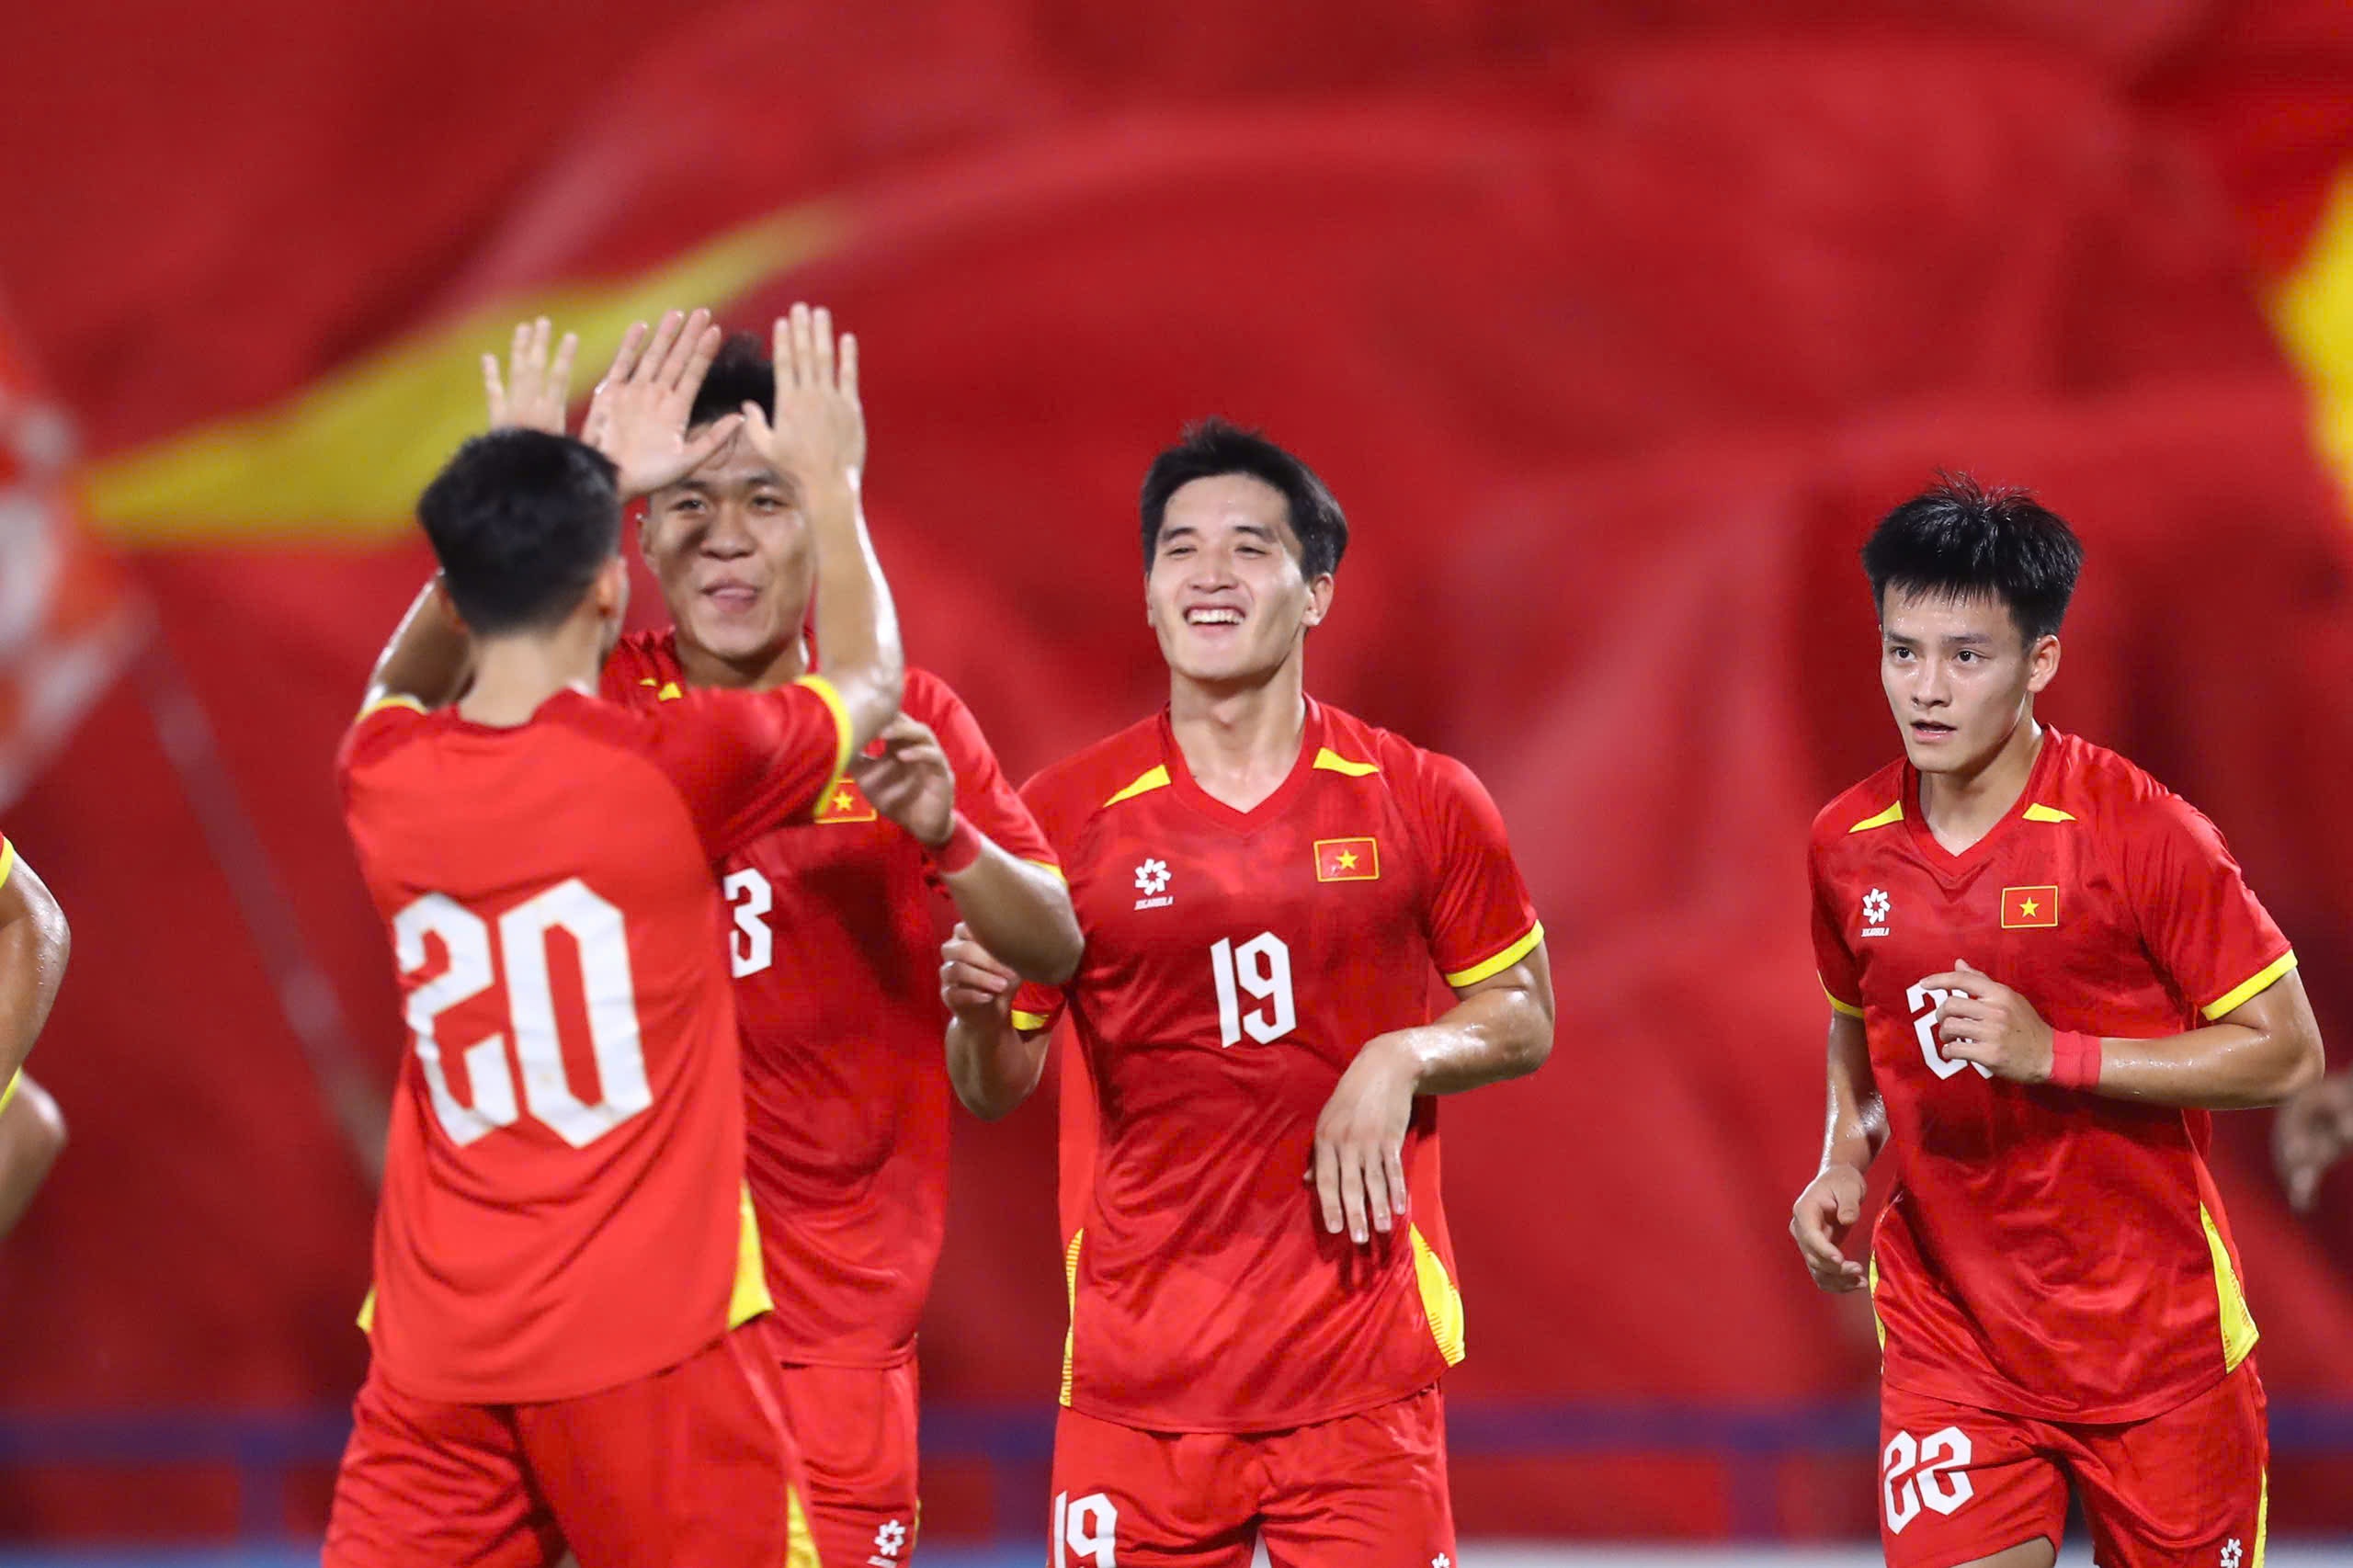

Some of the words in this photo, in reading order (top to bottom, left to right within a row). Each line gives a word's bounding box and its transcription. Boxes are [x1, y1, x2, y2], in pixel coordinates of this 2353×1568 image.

[723, 867, 773, 979] 3
[392, 876, 654, 1150] 20
[1210, 930, 1297, 1049] 19
[1905, 980, 1994, 1080] 2
[1053, 1490, 1118, 1568] 19
[1882, 1426, 1975, 1536] 22
